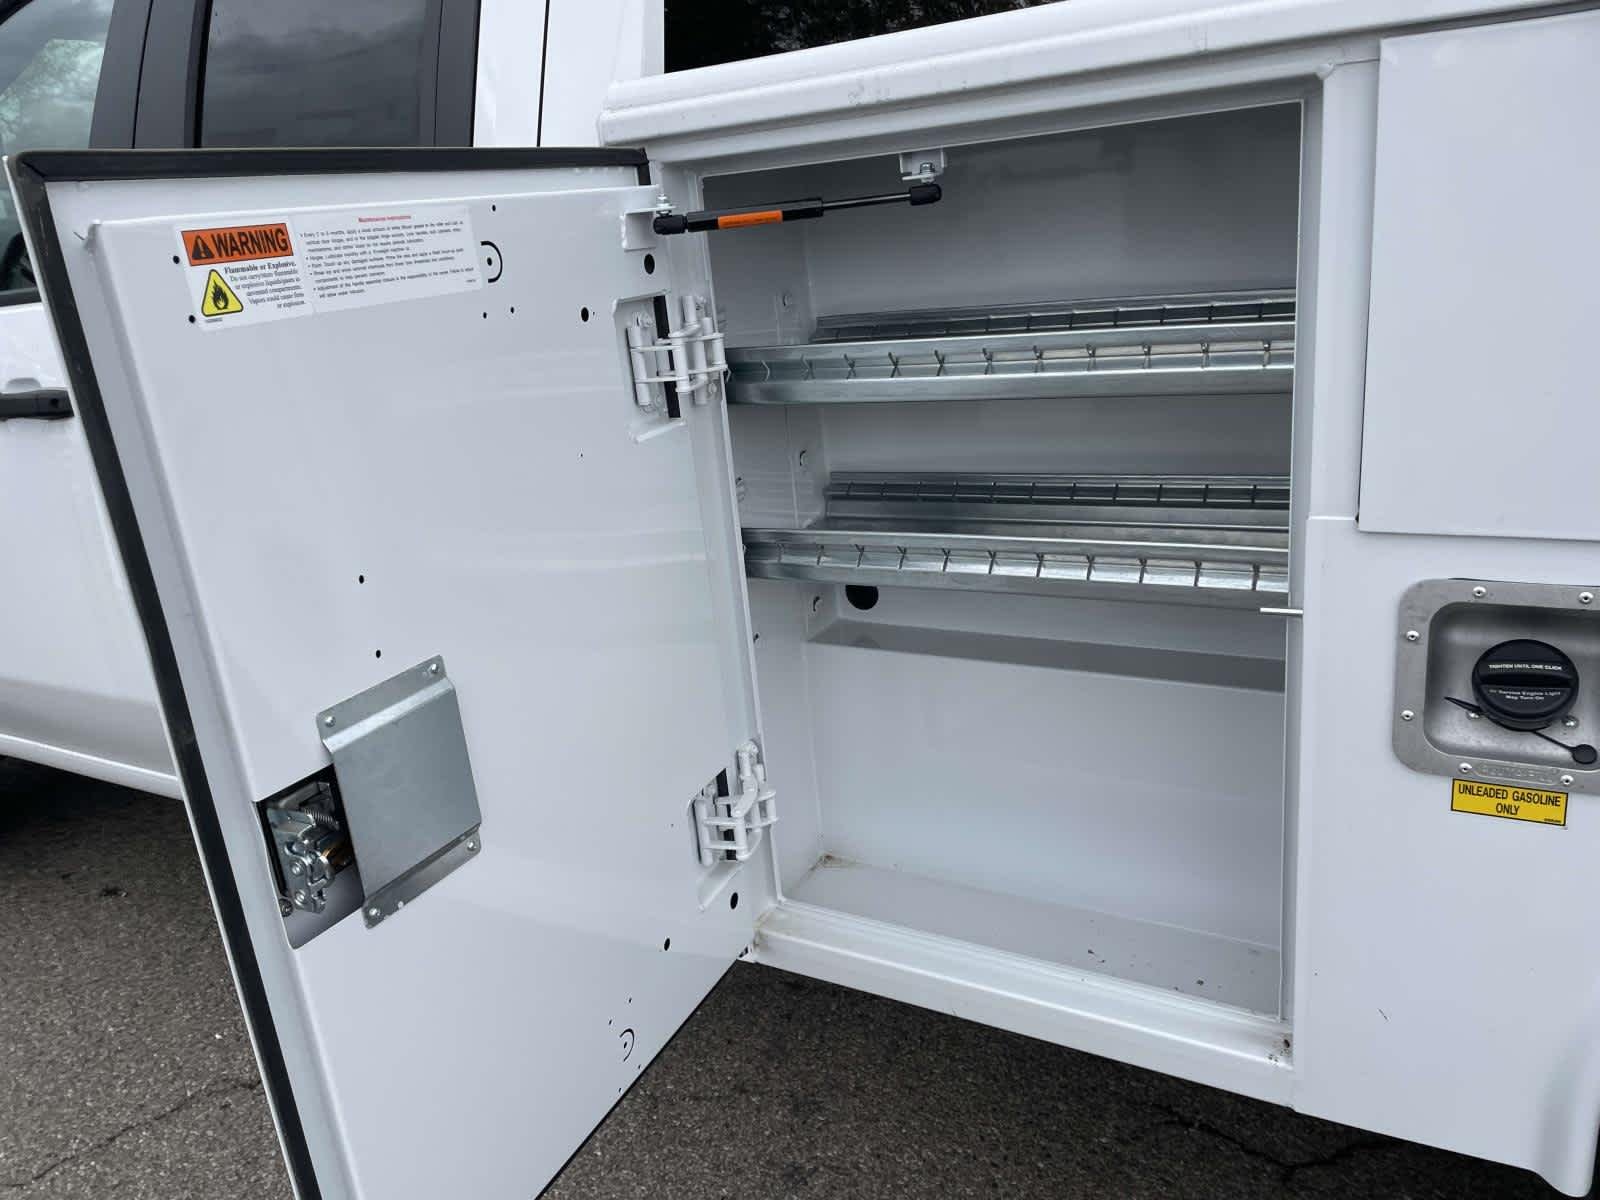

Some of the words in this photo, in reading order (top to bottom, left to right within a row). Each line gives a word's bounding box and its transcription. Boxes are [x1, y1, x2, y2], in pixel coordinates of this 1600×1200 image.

[211, 228, 289, 258] WARNING
[224, 265, 258, 274] Flammable
[1458, 783, 1508, 800] UNLEADED
[1512, 791, 1561, 807] GASOLINE
[1496, 803, 1520, 815] ONLY
